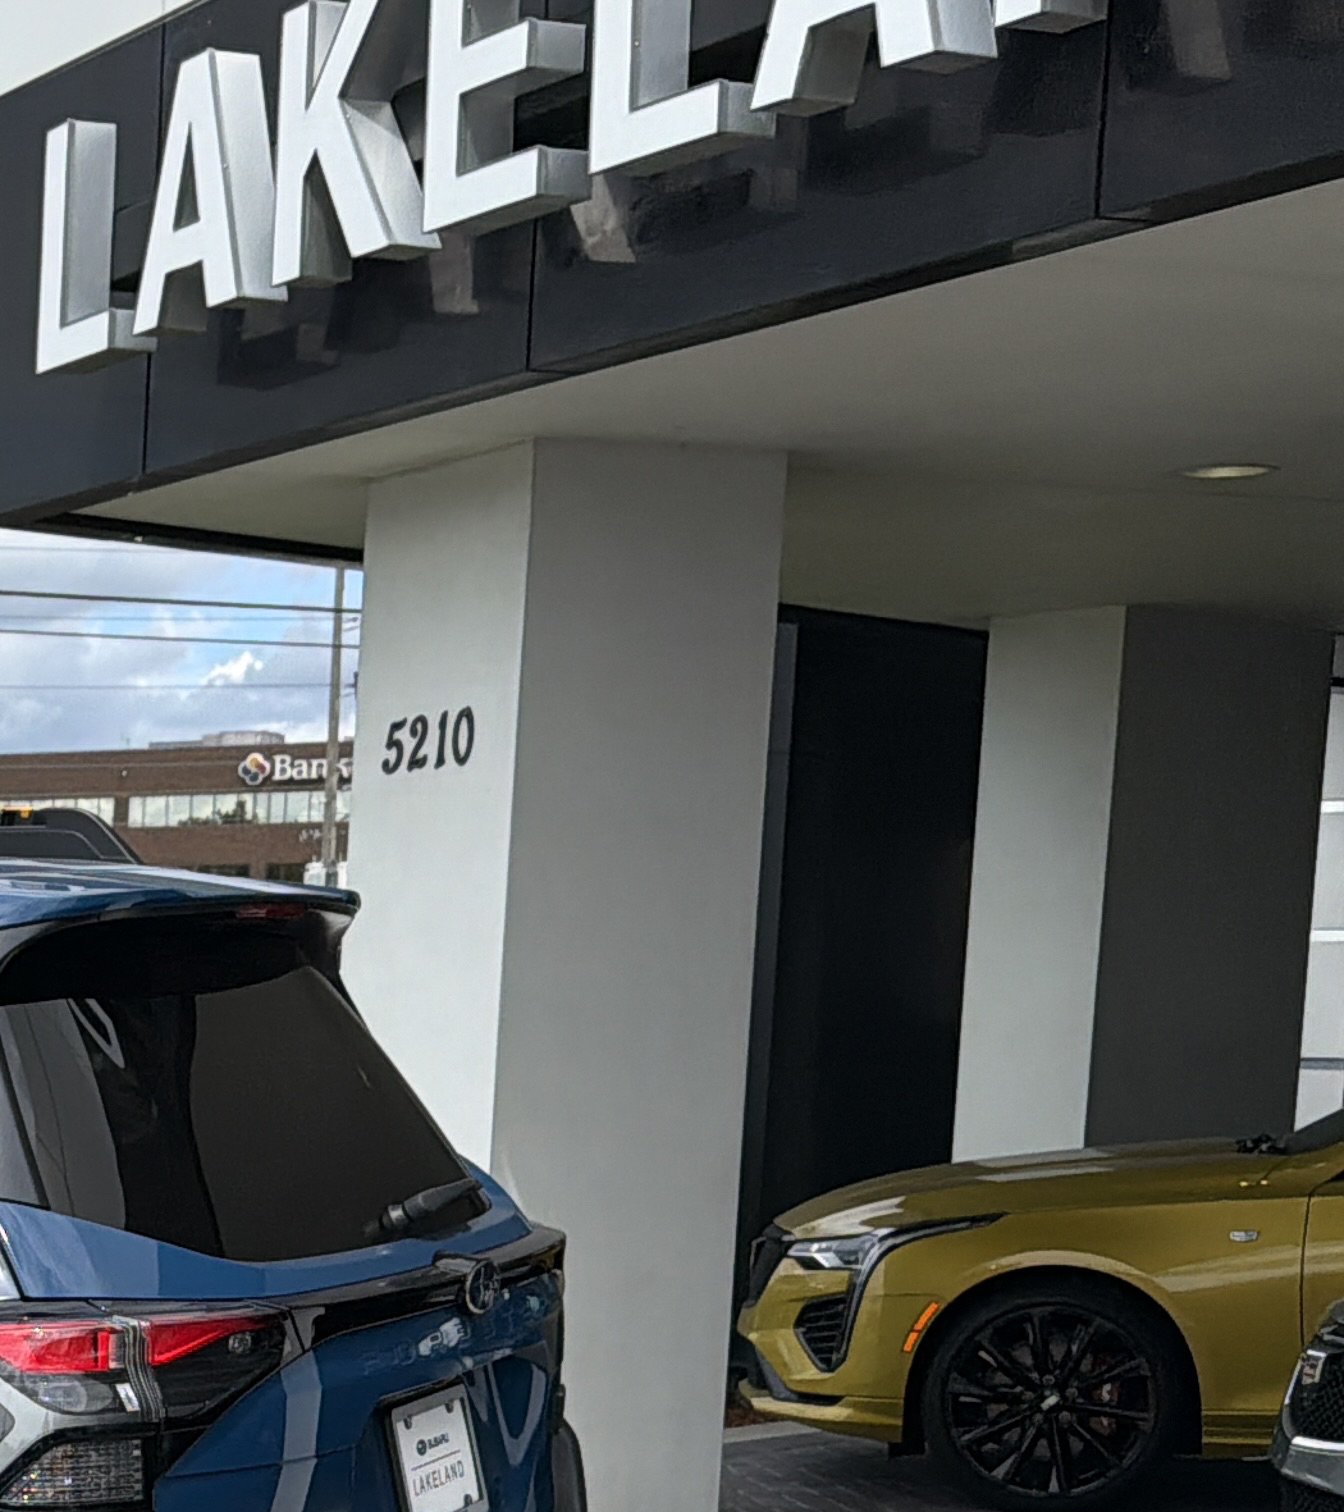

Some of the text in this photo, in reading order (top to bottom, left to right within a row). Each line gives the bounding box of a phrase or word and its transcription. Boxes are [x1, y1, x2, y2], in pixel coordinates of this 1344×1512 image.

[36, 0, 1107, 374] LAKEL
[381, 706, 474, 775] 5210
[412, 1460, 465, 1497] LAKELAND
